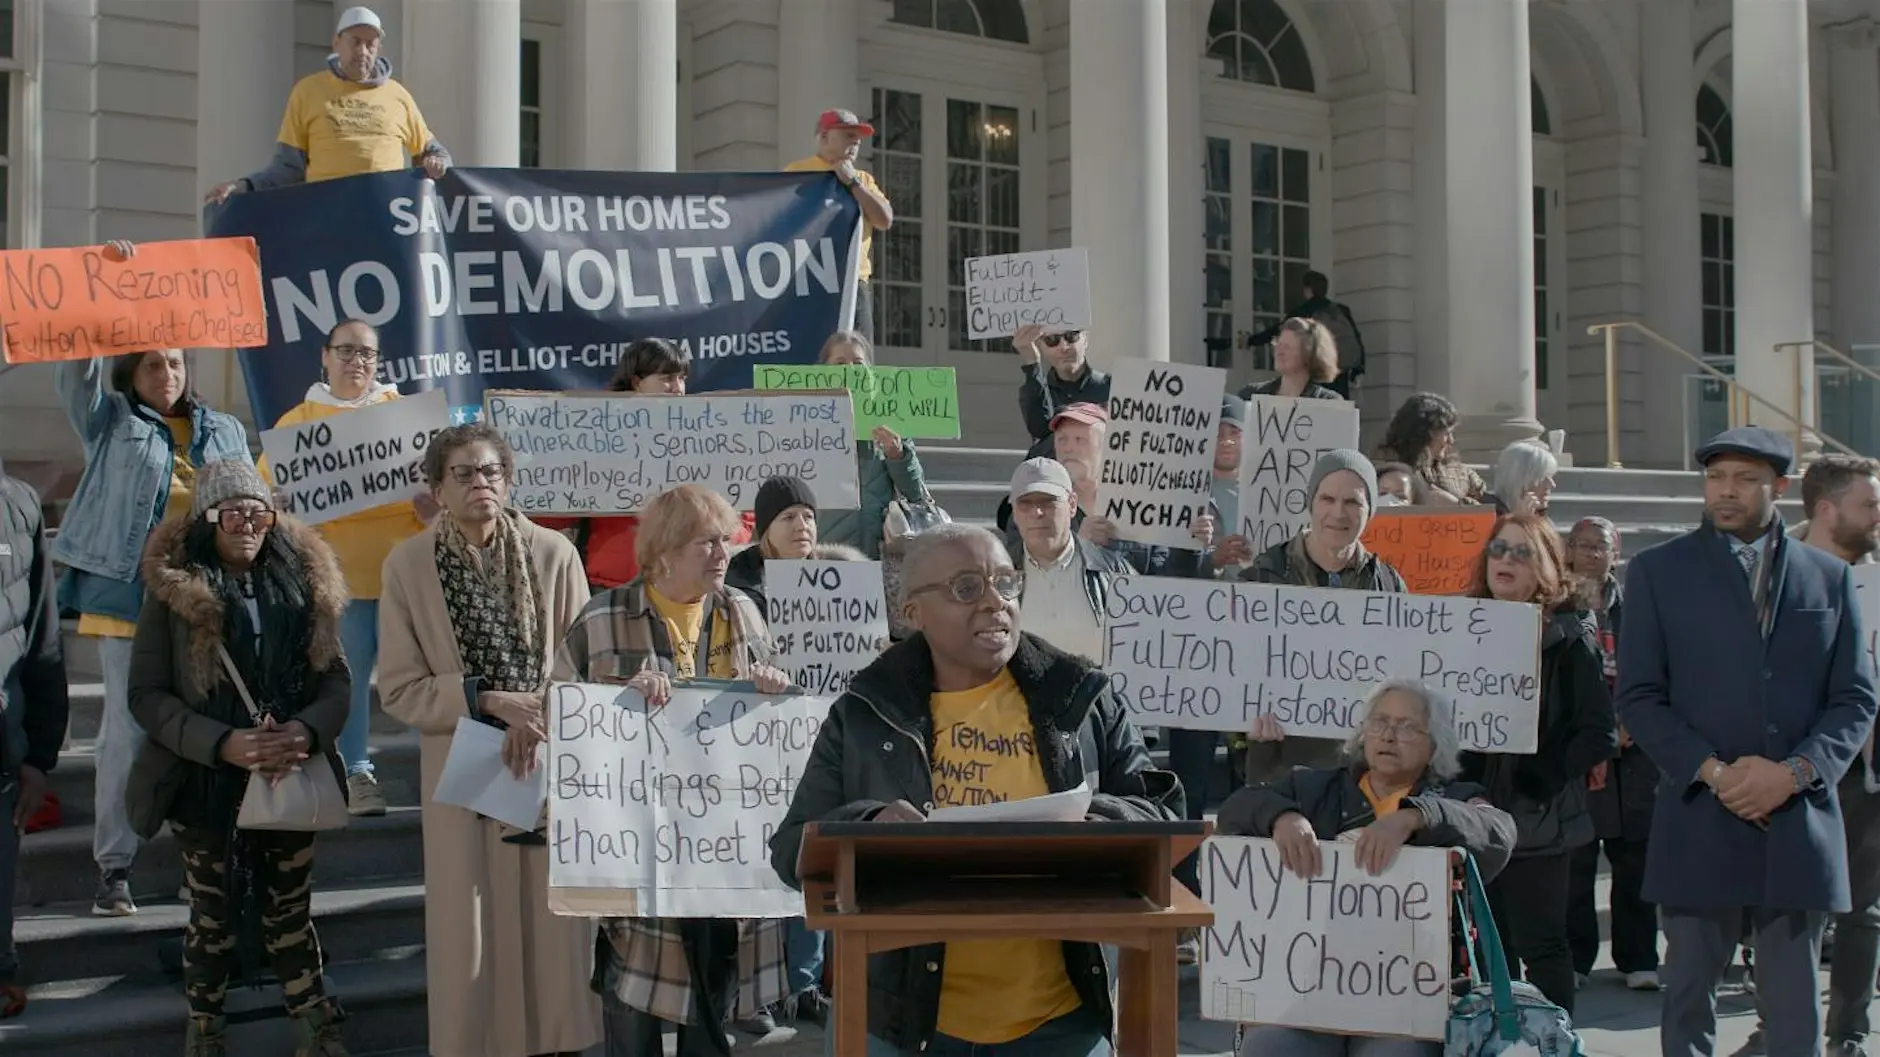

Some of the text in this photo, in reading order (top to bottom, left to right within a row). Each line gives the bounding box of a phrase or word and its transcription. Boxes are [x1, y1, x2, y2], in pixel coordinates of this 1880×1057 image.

[390, 195, 731, 236] SAVE OUR HOMES
[4, 251, 244, 318] NO Rezoning
[967, 255, 1060, 282] FuLton &
[271, 237, 839, 343] NO DEMOLITION
[4, 322, 93, 355] Fulton
[454, 352, 471, 374] &
[700, 330, 791, 359] HOUSES
[763, 367, 915, 398] Demolition
[1145, 369, 1184, 397] NO
[668, 404, 728, 431] Hurts
[742, 402, 773, 426] the
[789, 401, 840, 424] most
[909, 397, 956, 419] WiLL
[1110, 395, 1211, 430] DEMOLITION
[1256, 400, 1313, 446] We
[295, 421, 332, 453] NO
[757, 430, 850, 455] Disabled,
[1109, 430, 1131, 450] OF
[1140, 432, 1194, 456] FULTON
[274, 437, 401, 486] DEMOLITION
[666, 460, 711, 483] Low
[725, 458, 817, 481] income
[1101, 459, 1211, 494] ELLIOTT/CHELSEA
[798, 566, 841, 591] NO
[770, 596, 878, 625] DEMOLITION
[1107, 576, 1492, 645] Save Chelsea Elliott &
[803, 631, 873, 655] FULTON
[1107, 622, 1537, 701] FuLTon Houses Preserve
[1110, 672, 1221, 718] RetRO
[557, 684, 672, 755] BRicK
[695, 698, 716, 755] &
[557, 754, 800, 818] Buildings Bet
[552, 817, 640, 865] than
[654, 820, 748, 865] sheet
[1208, 841, 1431, 921] MY Home
[1204, 920, 1445, 996] My Choice
